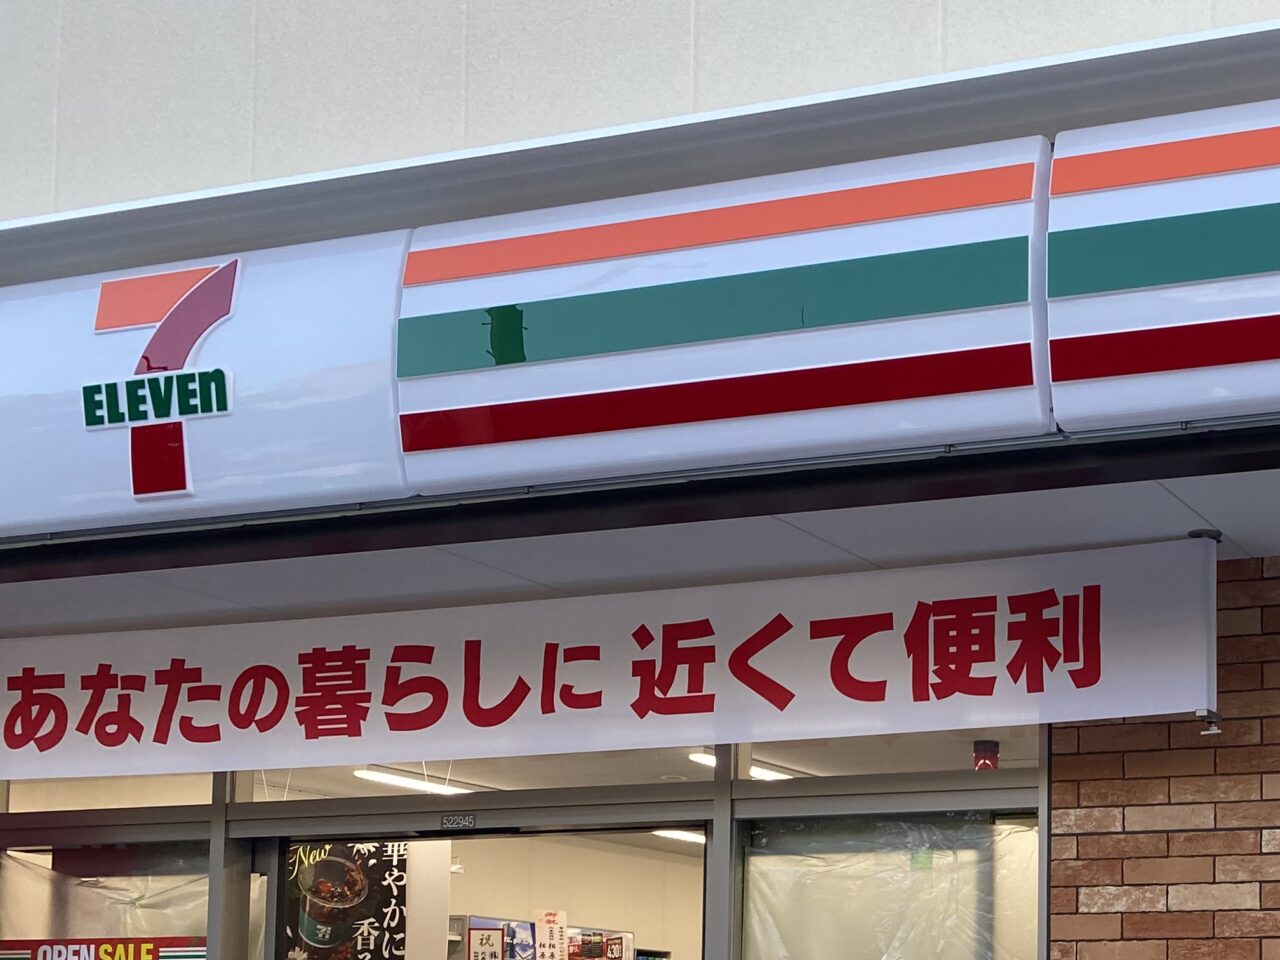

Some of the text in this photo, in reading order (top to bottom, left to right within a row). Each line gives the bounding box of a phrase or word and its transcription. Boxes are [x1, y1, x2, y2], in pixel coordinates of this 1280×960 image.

[3, 584, 1102, 752] あなたの暮らしに 近くて便利
[442, 815, 475, 828] 522945
[288, 843, 333, 881] New
[479, 933, 495, 948] 祝
